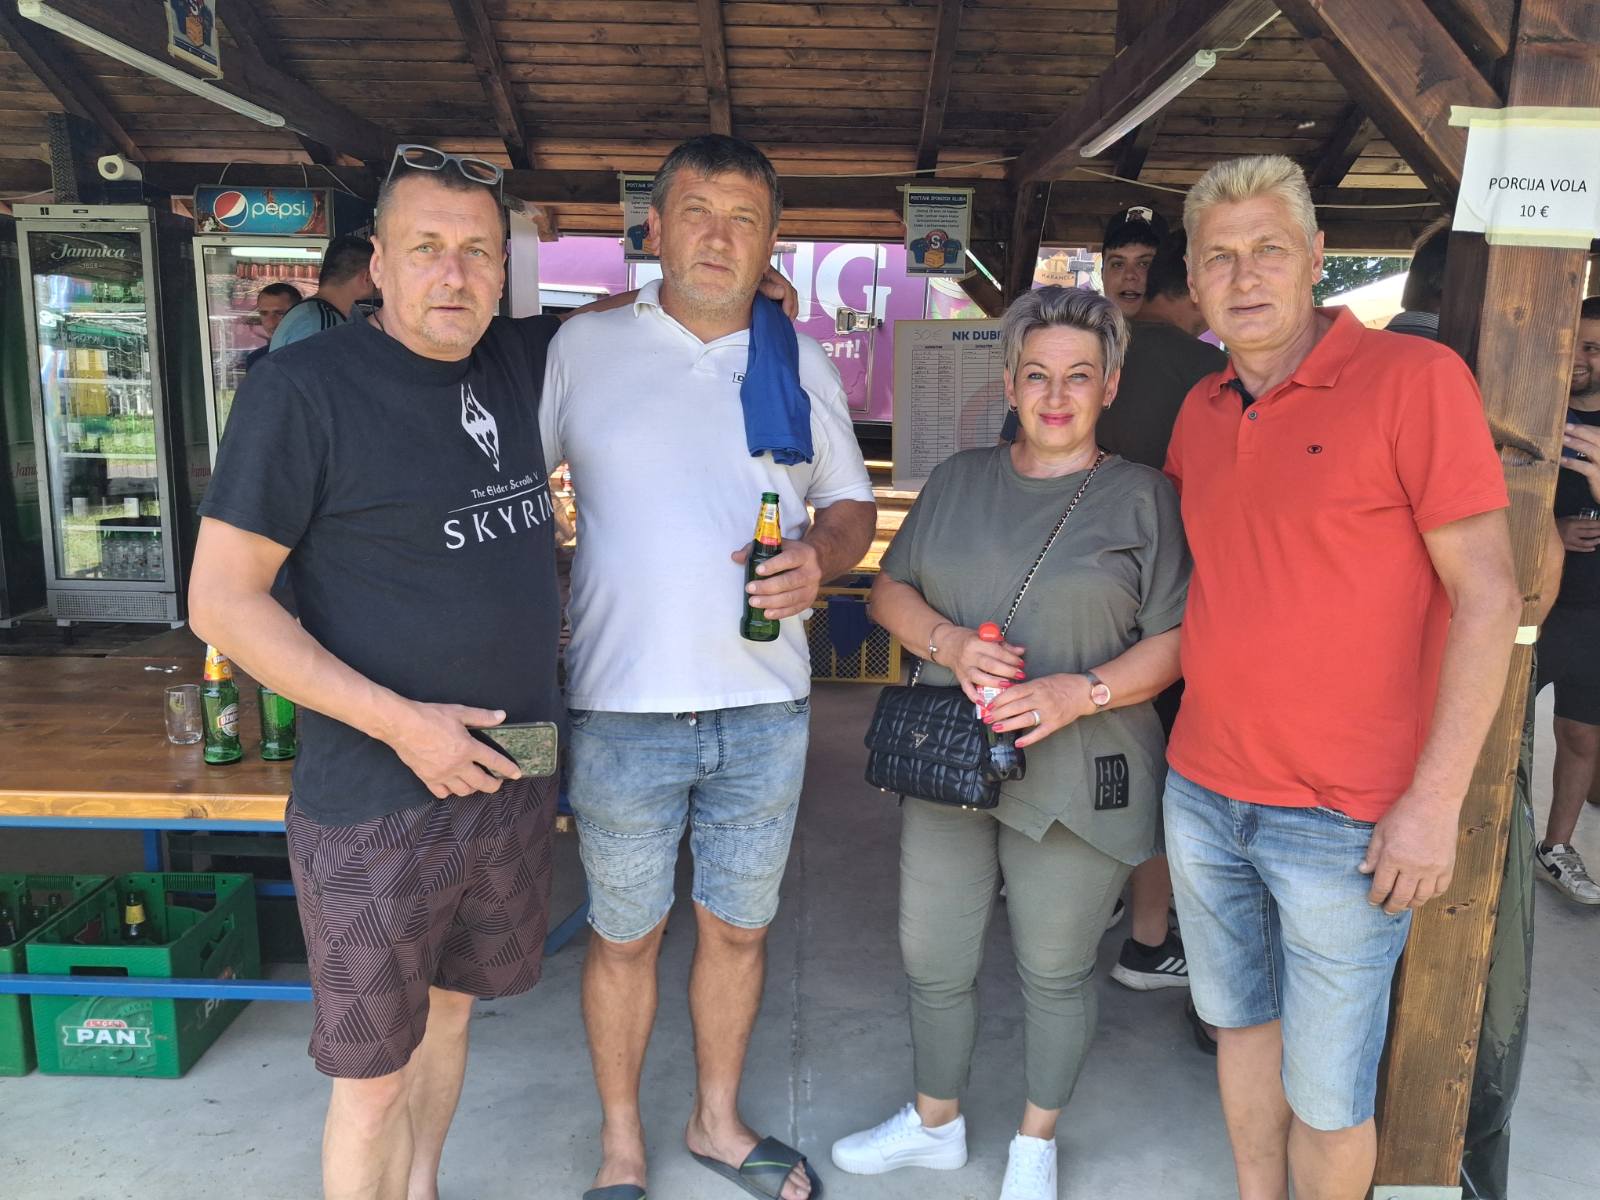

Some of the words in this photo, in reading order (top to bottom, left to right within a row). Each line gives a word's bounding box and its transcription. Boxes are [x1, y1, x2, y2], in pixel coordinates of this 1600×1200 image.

[1489, 177, 1545, 191] PORCIJA
[1550, 179, 1587, 192] VOLA
[252, 201, 306, 219] pepsi
[1520, 204, 1536, 217] 10
[1540, 205, 1550, 218] €
[51, 244, 126, 262] Jamnica
[952, 331, 970, 341] NK
[471, 488, 487, 499] The
[486, 483, 509, 497] Elder
[76, 1029, 136, 1045] PAN
